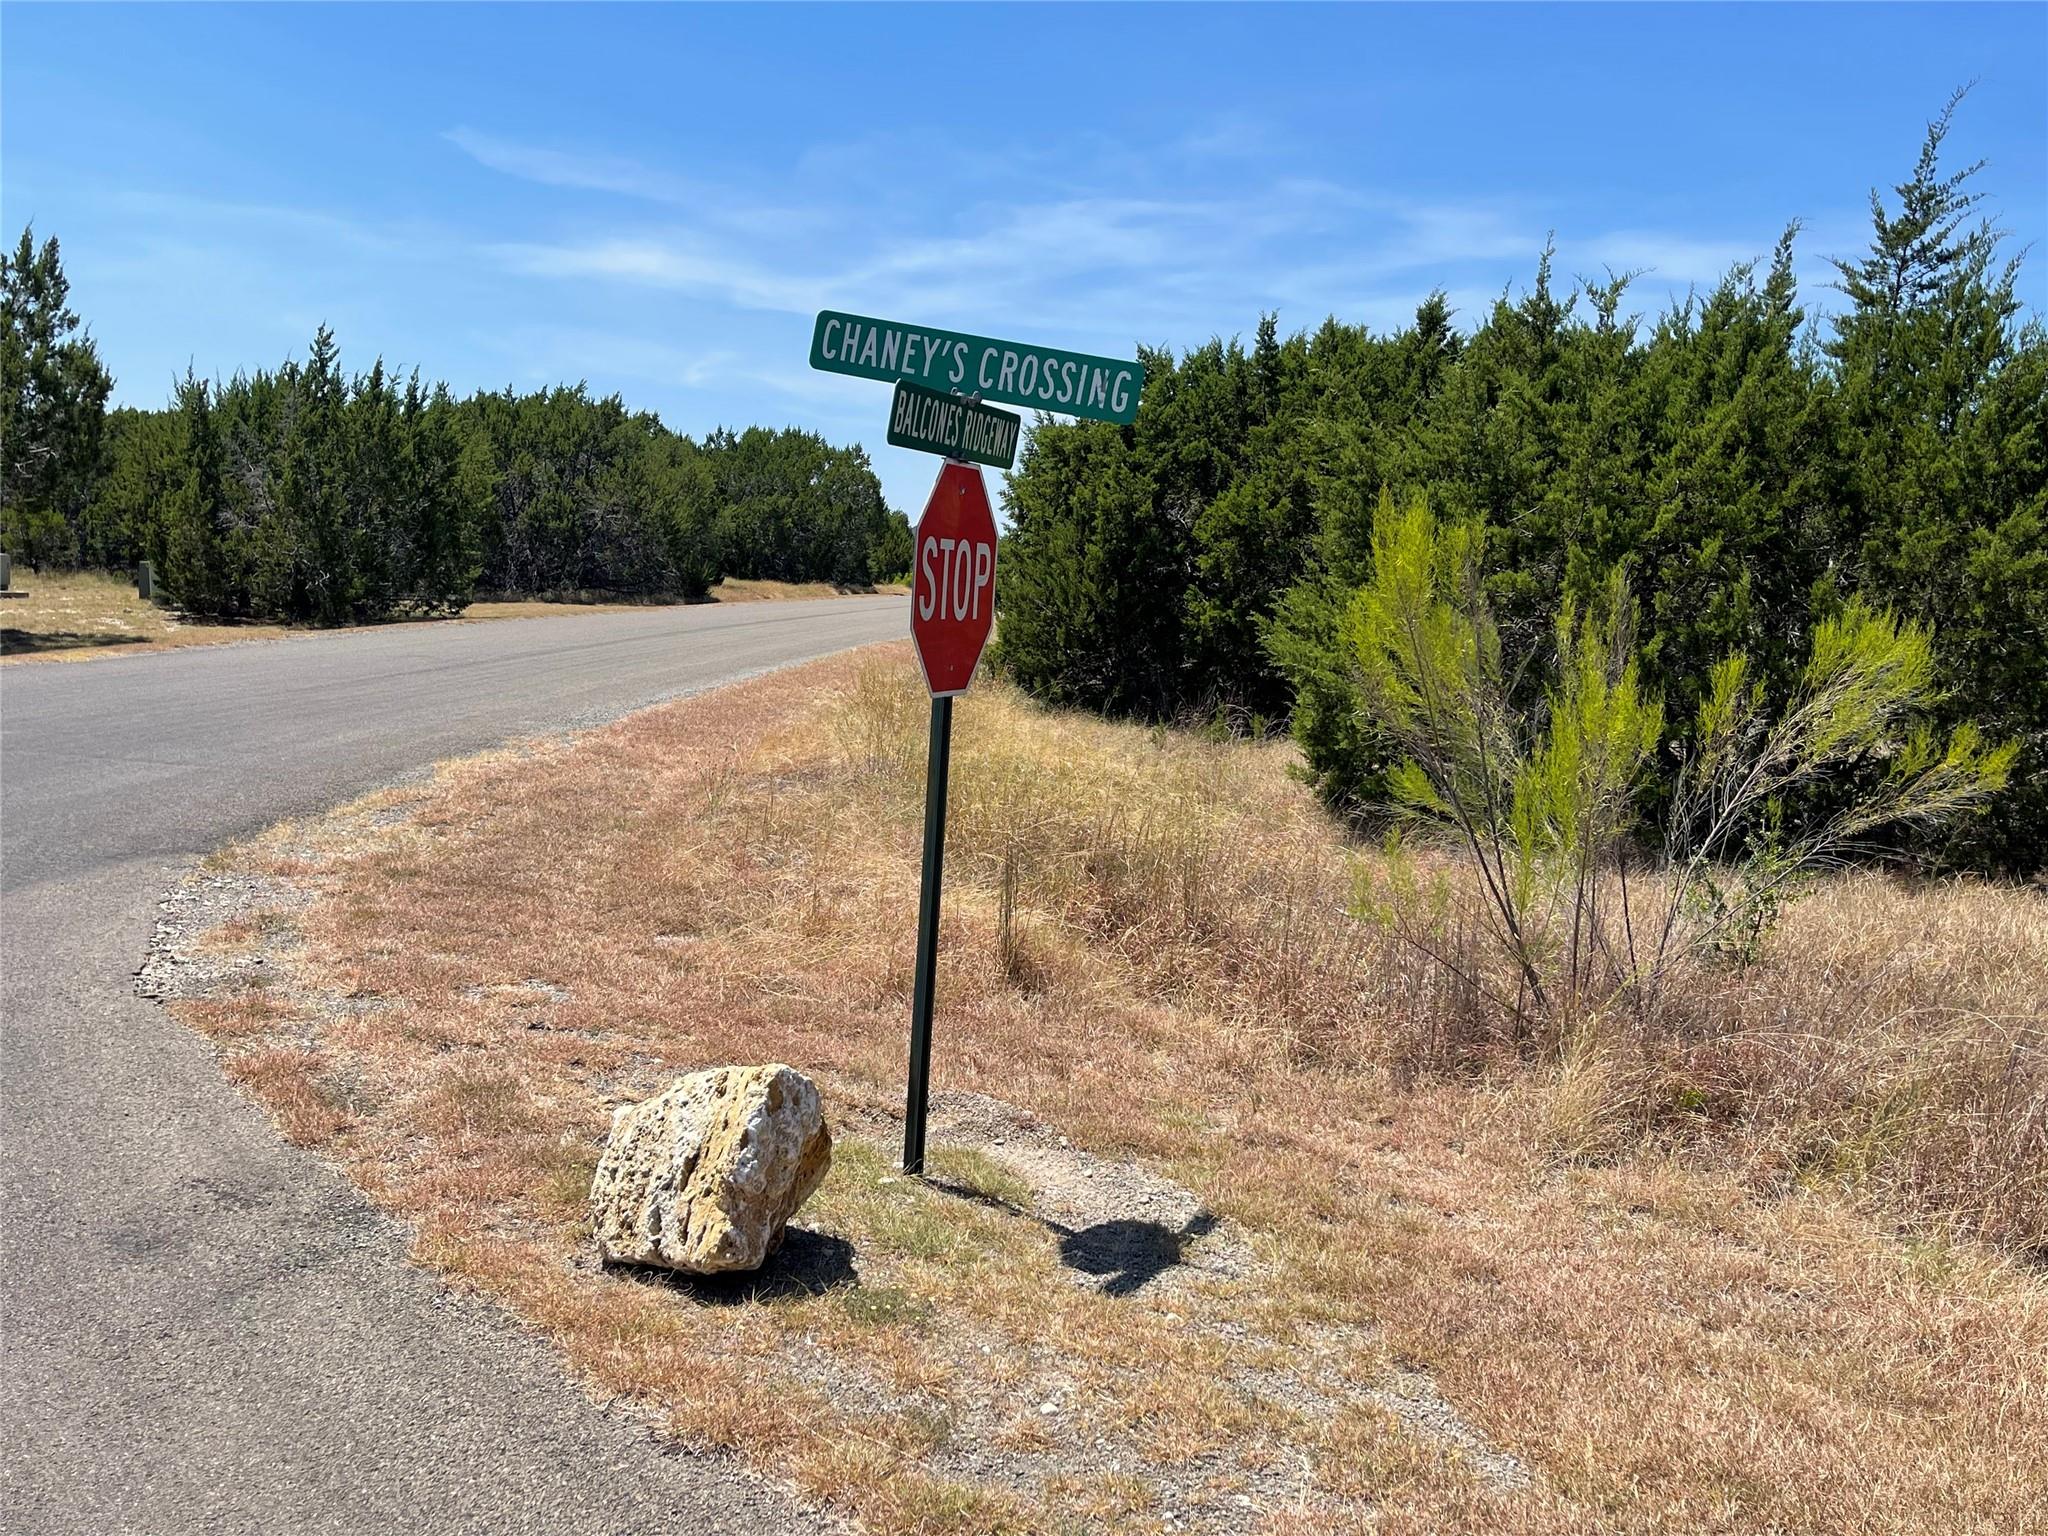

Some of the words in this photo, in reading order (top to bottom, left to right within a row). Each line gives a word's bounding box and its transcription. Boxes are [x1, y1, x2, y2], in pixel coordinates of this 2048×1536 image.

[821, 319, 968, 384] CHANEY'S
[978, 347, 1132, 413] CROSSING
[893, 390, 962, 447] BALCONES
[961, 409, 1018, 460] RIDGEWAY
[919, 536, 991, 621] STOP
